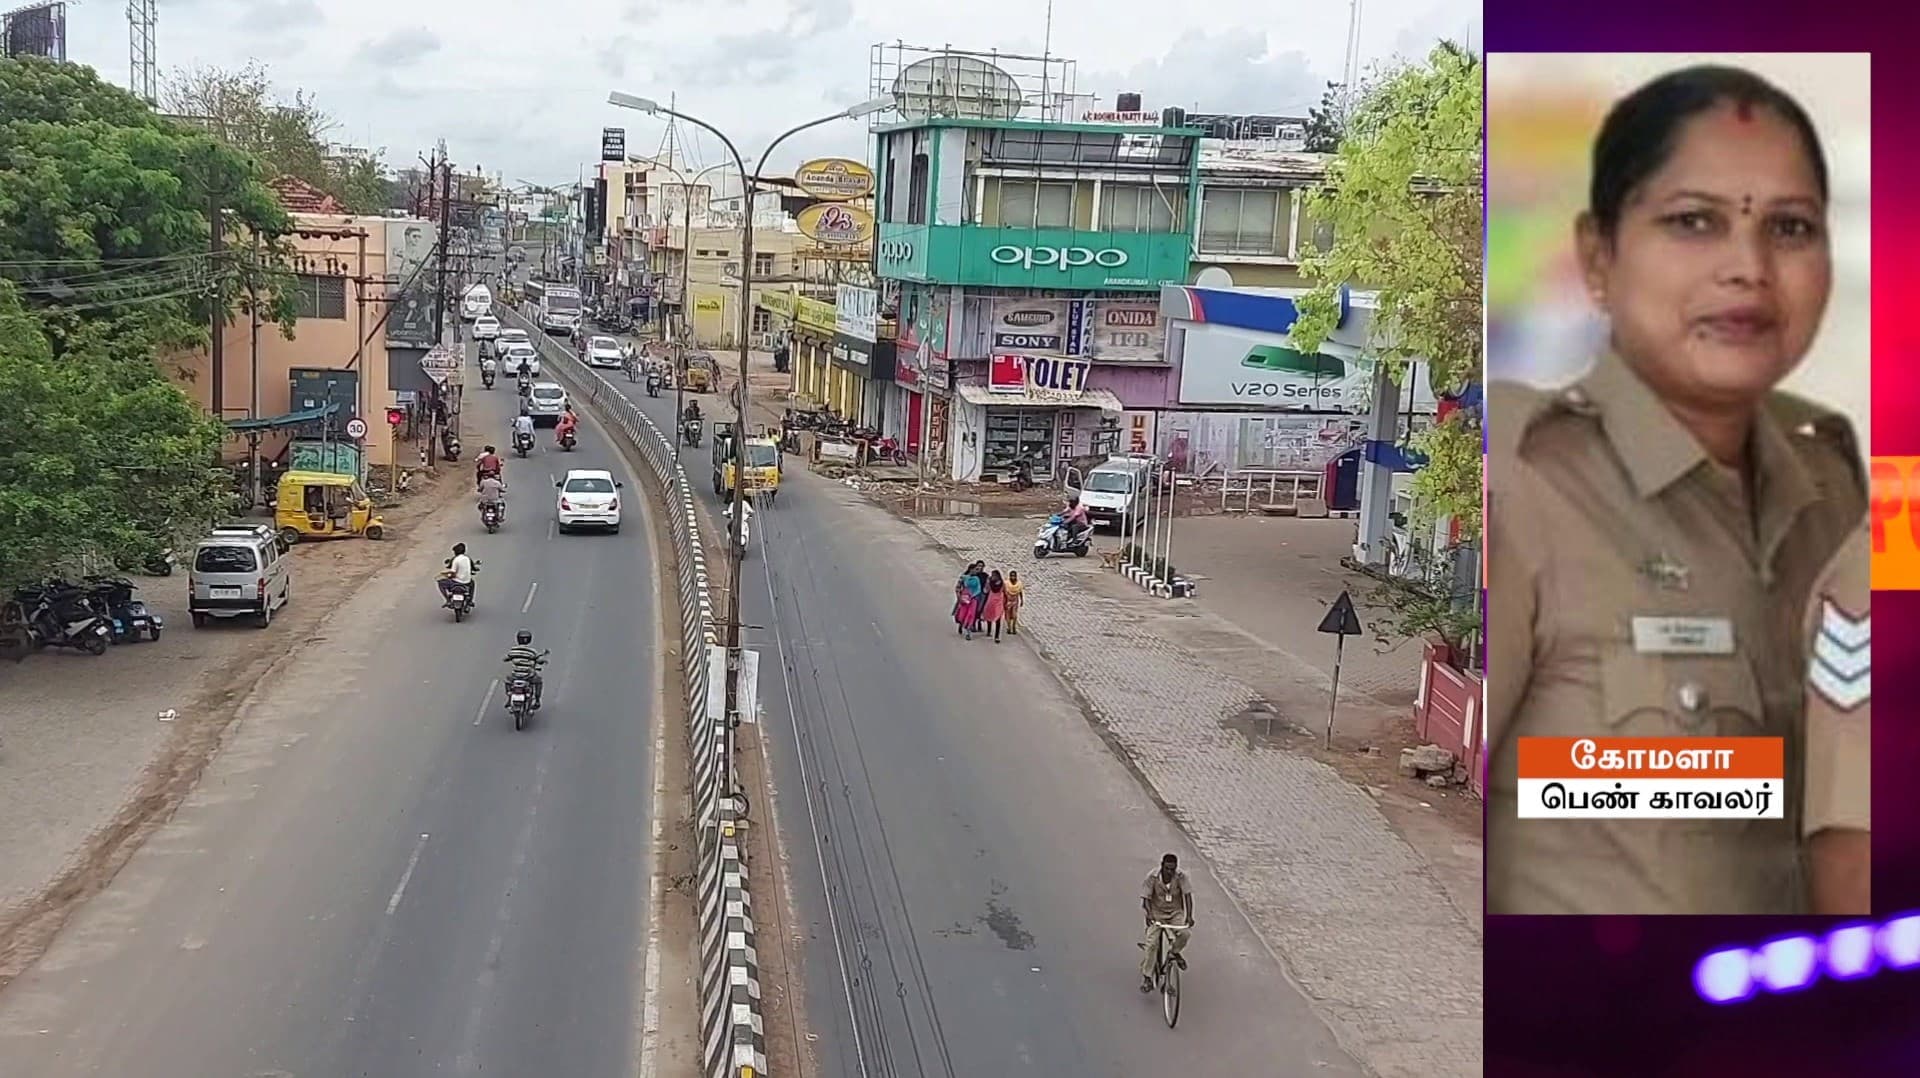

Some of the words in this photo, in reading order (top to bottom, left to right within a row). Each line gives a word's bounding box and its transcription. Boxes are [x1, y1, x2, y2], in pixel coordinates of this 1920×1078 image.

[1107, 311, 1153, 325] ONIDA
[1001, 334, 1055, 348] SONY
[1231, 382, 1279, 397] V20
[1283, 383, 1342, 398] Series
[350, 424, 363, 433] 30
